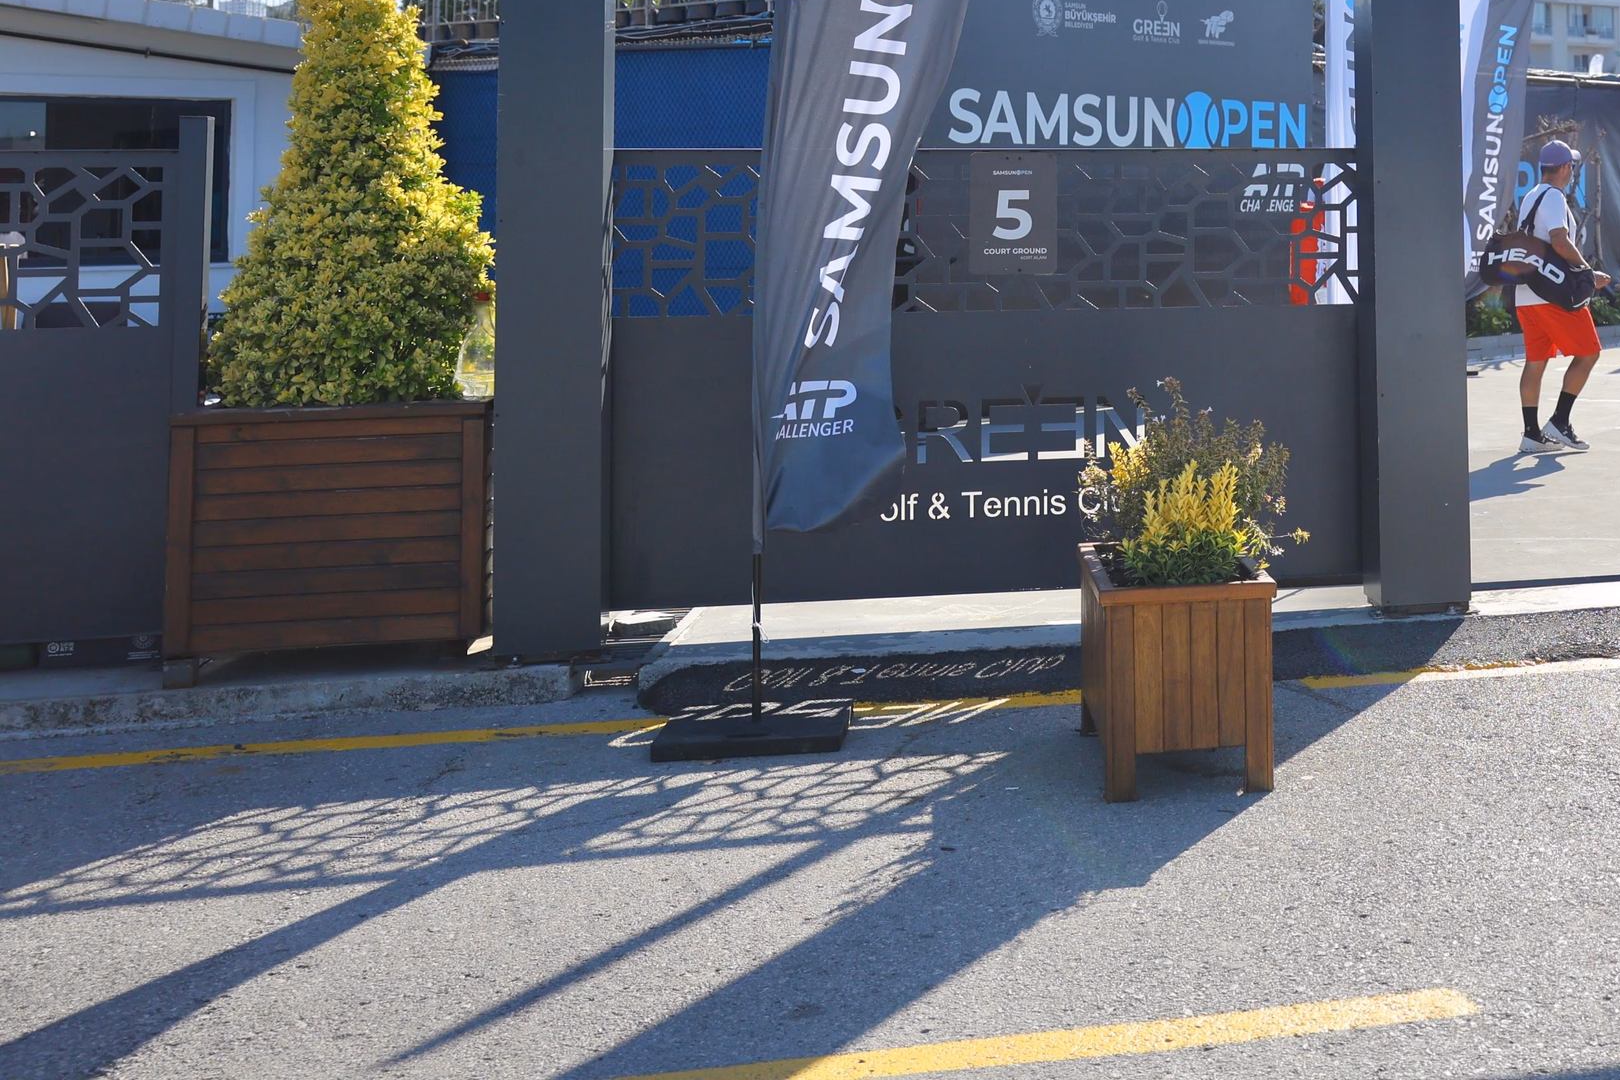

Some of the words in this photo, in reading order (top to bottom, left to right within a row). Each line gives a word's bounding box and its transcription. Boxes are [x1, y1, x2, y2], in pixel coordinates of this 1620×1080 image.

[948, 87, 1307, 149] SAMSUNOPEN
[992, 189, 1033, 240] 5
[1012, 247, 1048, 255] GROUND
[1487, 247, 1566, 285] HEAD
[928, 492, 950, 520] &
[961, 488, 1067, 519] Tennis
